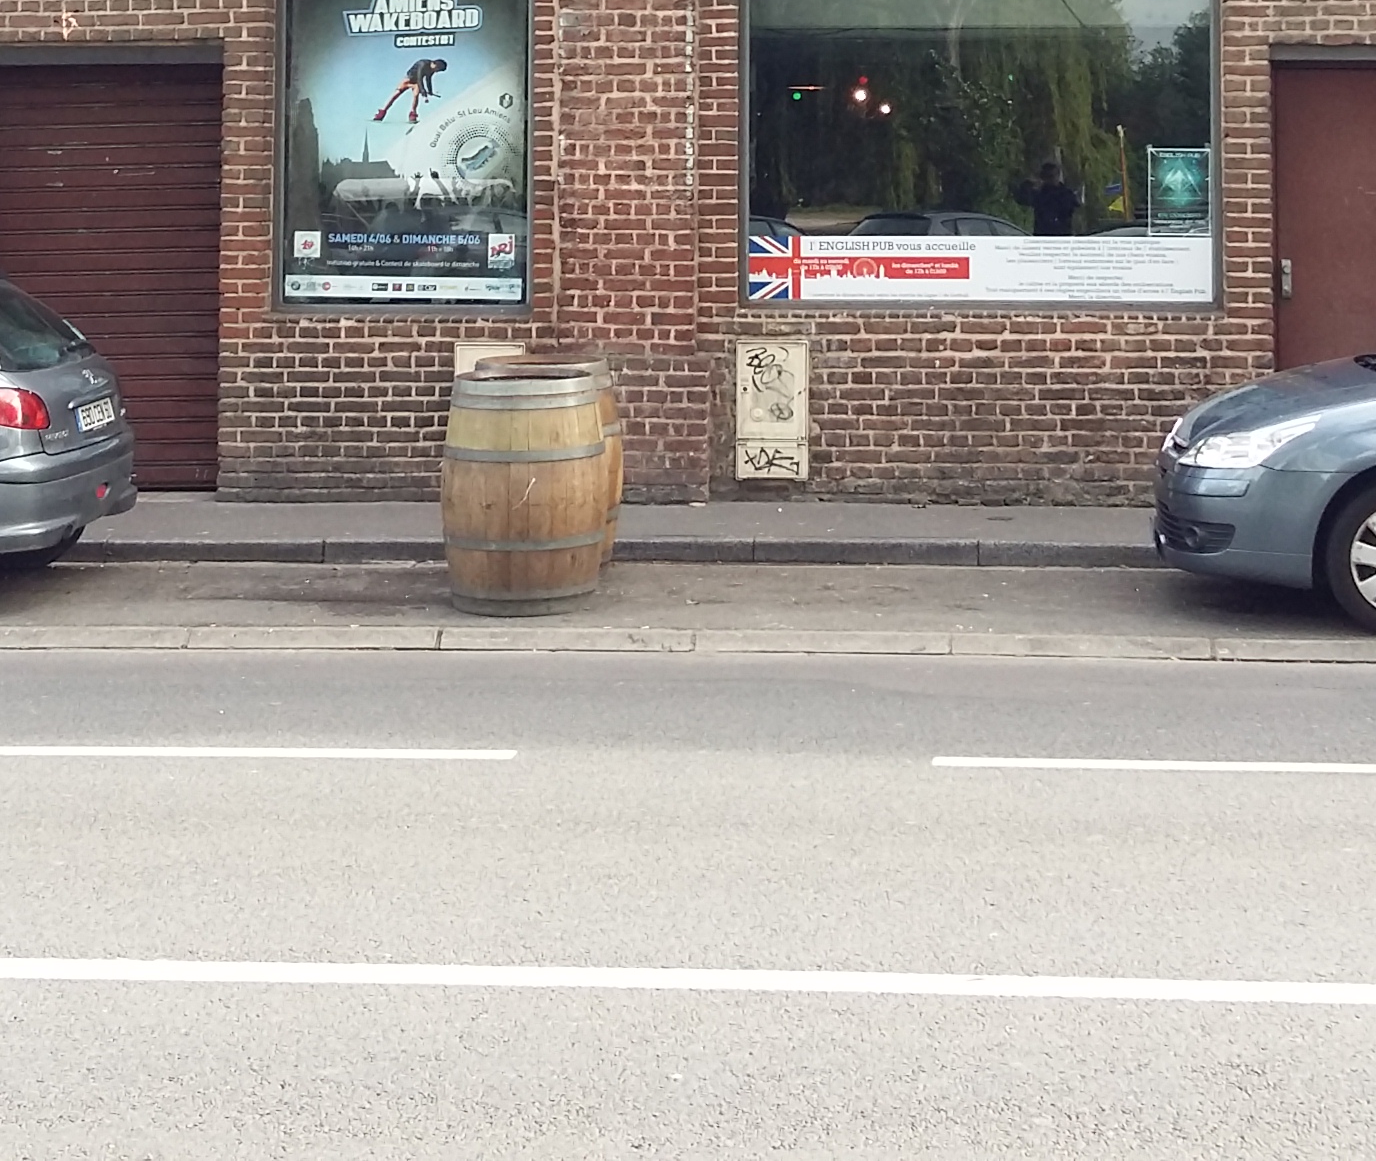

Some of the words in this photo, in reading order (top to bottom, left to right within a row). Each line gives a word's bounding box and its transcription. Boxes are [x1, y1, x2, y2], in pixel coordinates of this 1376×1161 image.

[348, 9, 479, 33] WAKEBOARD
[467, 107, 483, 115] Leu
[484, 107, 511, 124] Amiens
[328, 233, 367, 243] SAMEDI
[368, 232, 392, 244] 4/06
[393, 234, 401, 243] &
[402, 234, 457, 244] DIMANCHE
[457, 234, 481, 245] 5/06
[818, 240, 870, 251] ENGLISH
[871, 240, 895, 251] PUB
[895, 242, 922, 251] vous
[924, 240, 977, 251] accueille
